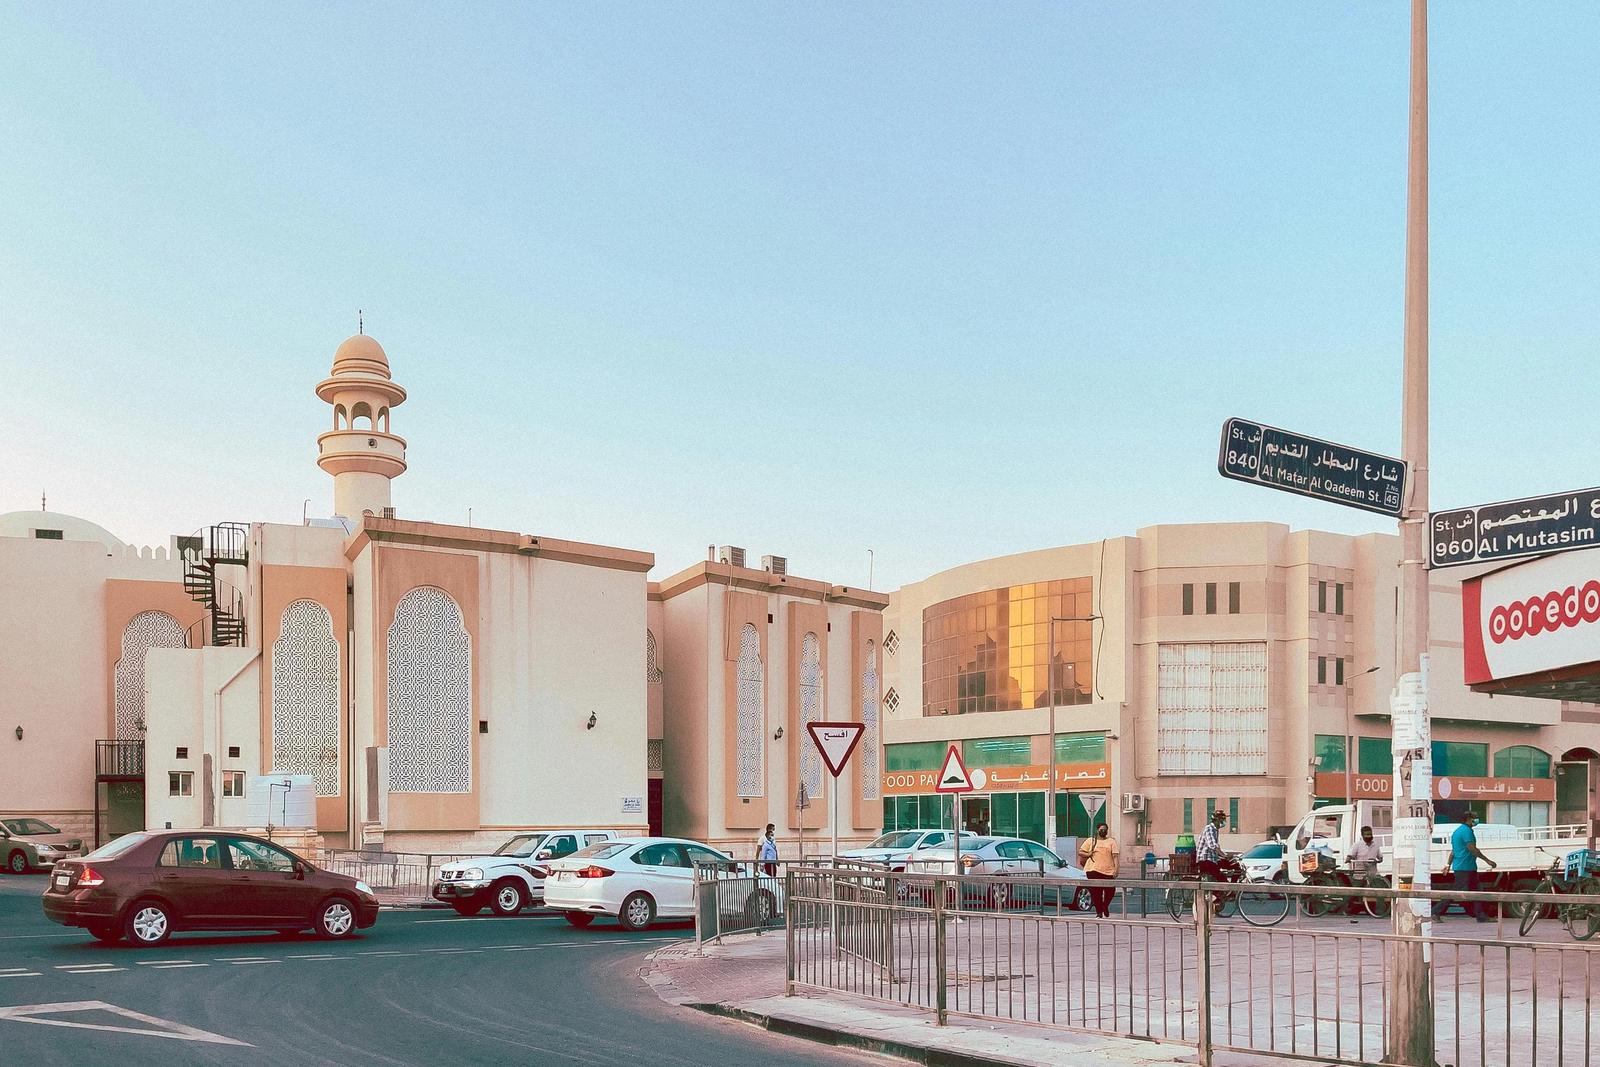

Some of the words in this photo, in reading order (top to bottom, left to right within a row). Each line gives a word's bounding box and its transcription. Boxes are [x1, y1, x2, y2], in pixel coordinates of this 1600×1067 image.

[1232, 428, 1246, 441] St.
[1265, 441, 1309, 459] القديم
[1228, 451, 1258, 469] 840
[1313, 449, 1359, 472] المطار
[1364, 464, 1399, 482] شارع
[1262, 464, 1273, 477] Al
[1277, 468, 1307, 485] Matar
[1310, 476, 1321, 489] Al
[1324, 479, 1365, 499] Qadeem
[1368, 490, 1382, 503] St.
[1386, 493, 1398, 505] 45
[1479, 497, 1578, 535] المعتصم
[1435, 521, 1454, 532] St.
[1435, 538, 1474, 557] 960
[1478, 538, 1499, 554] Al
[1507, 526, 1594, 550] Mutasim
[1355, 779, 1389, 792] FOOD
